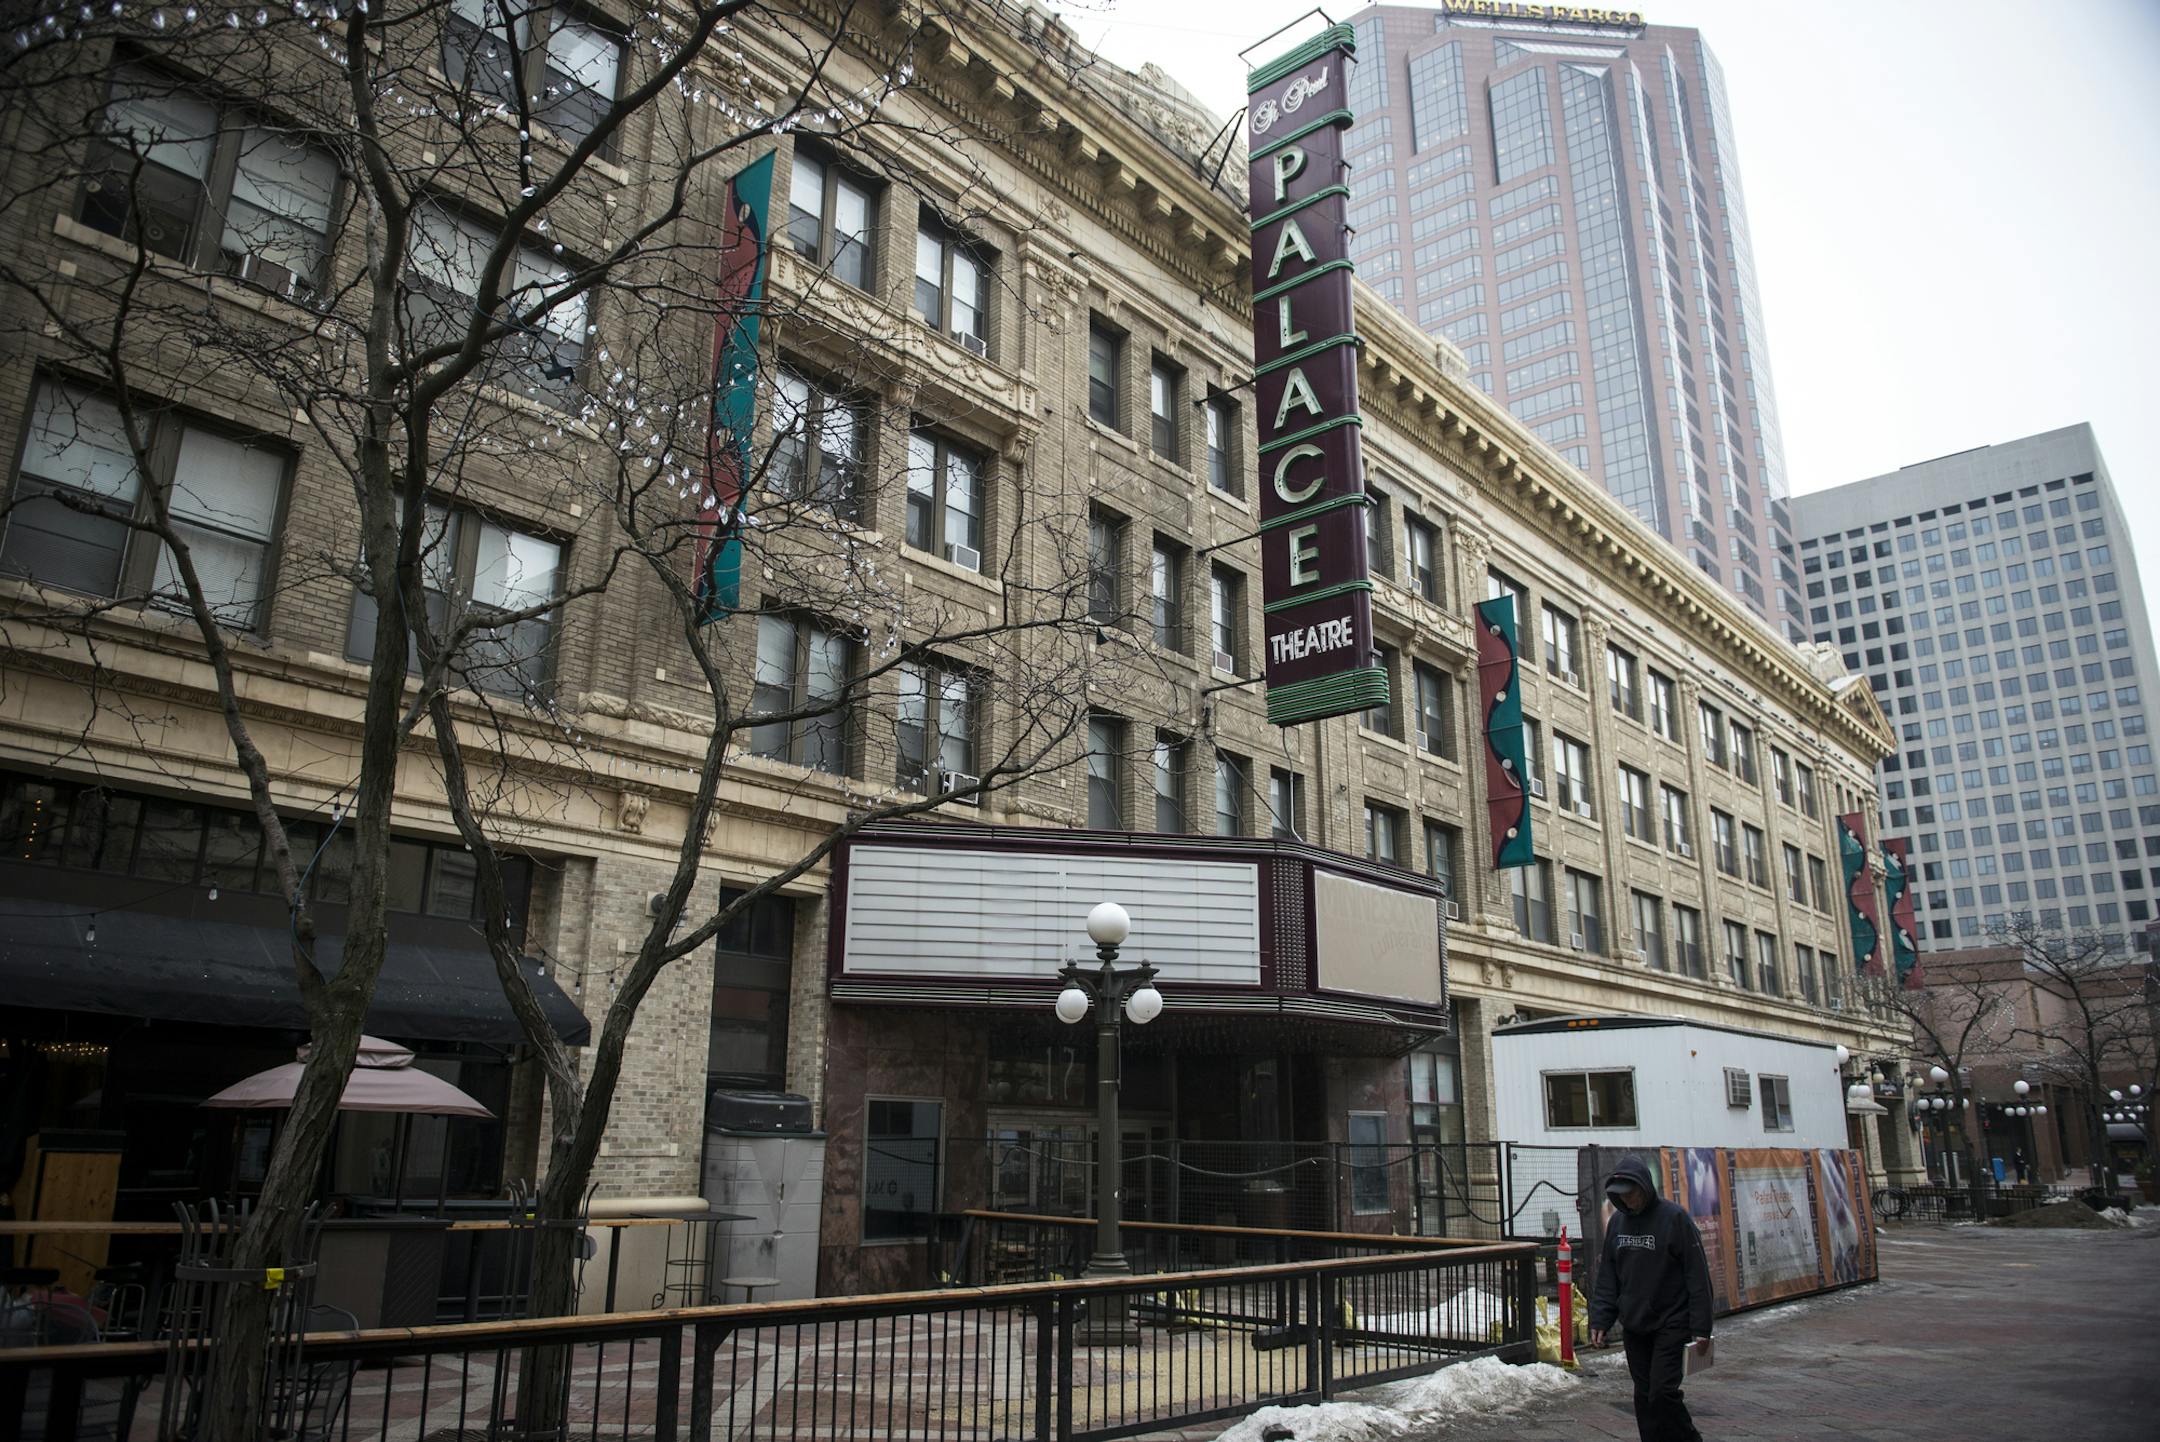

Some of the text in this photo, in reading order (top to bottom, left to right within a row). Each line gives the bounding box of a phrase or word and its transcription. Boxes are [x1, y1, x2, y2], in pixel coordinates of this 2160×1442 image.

[1443, 0, 1645, 26] WELLS FARGO
[1267, 145, 1326, 588] PALACE
[1269, 615, 1353, 665] THEATRE
